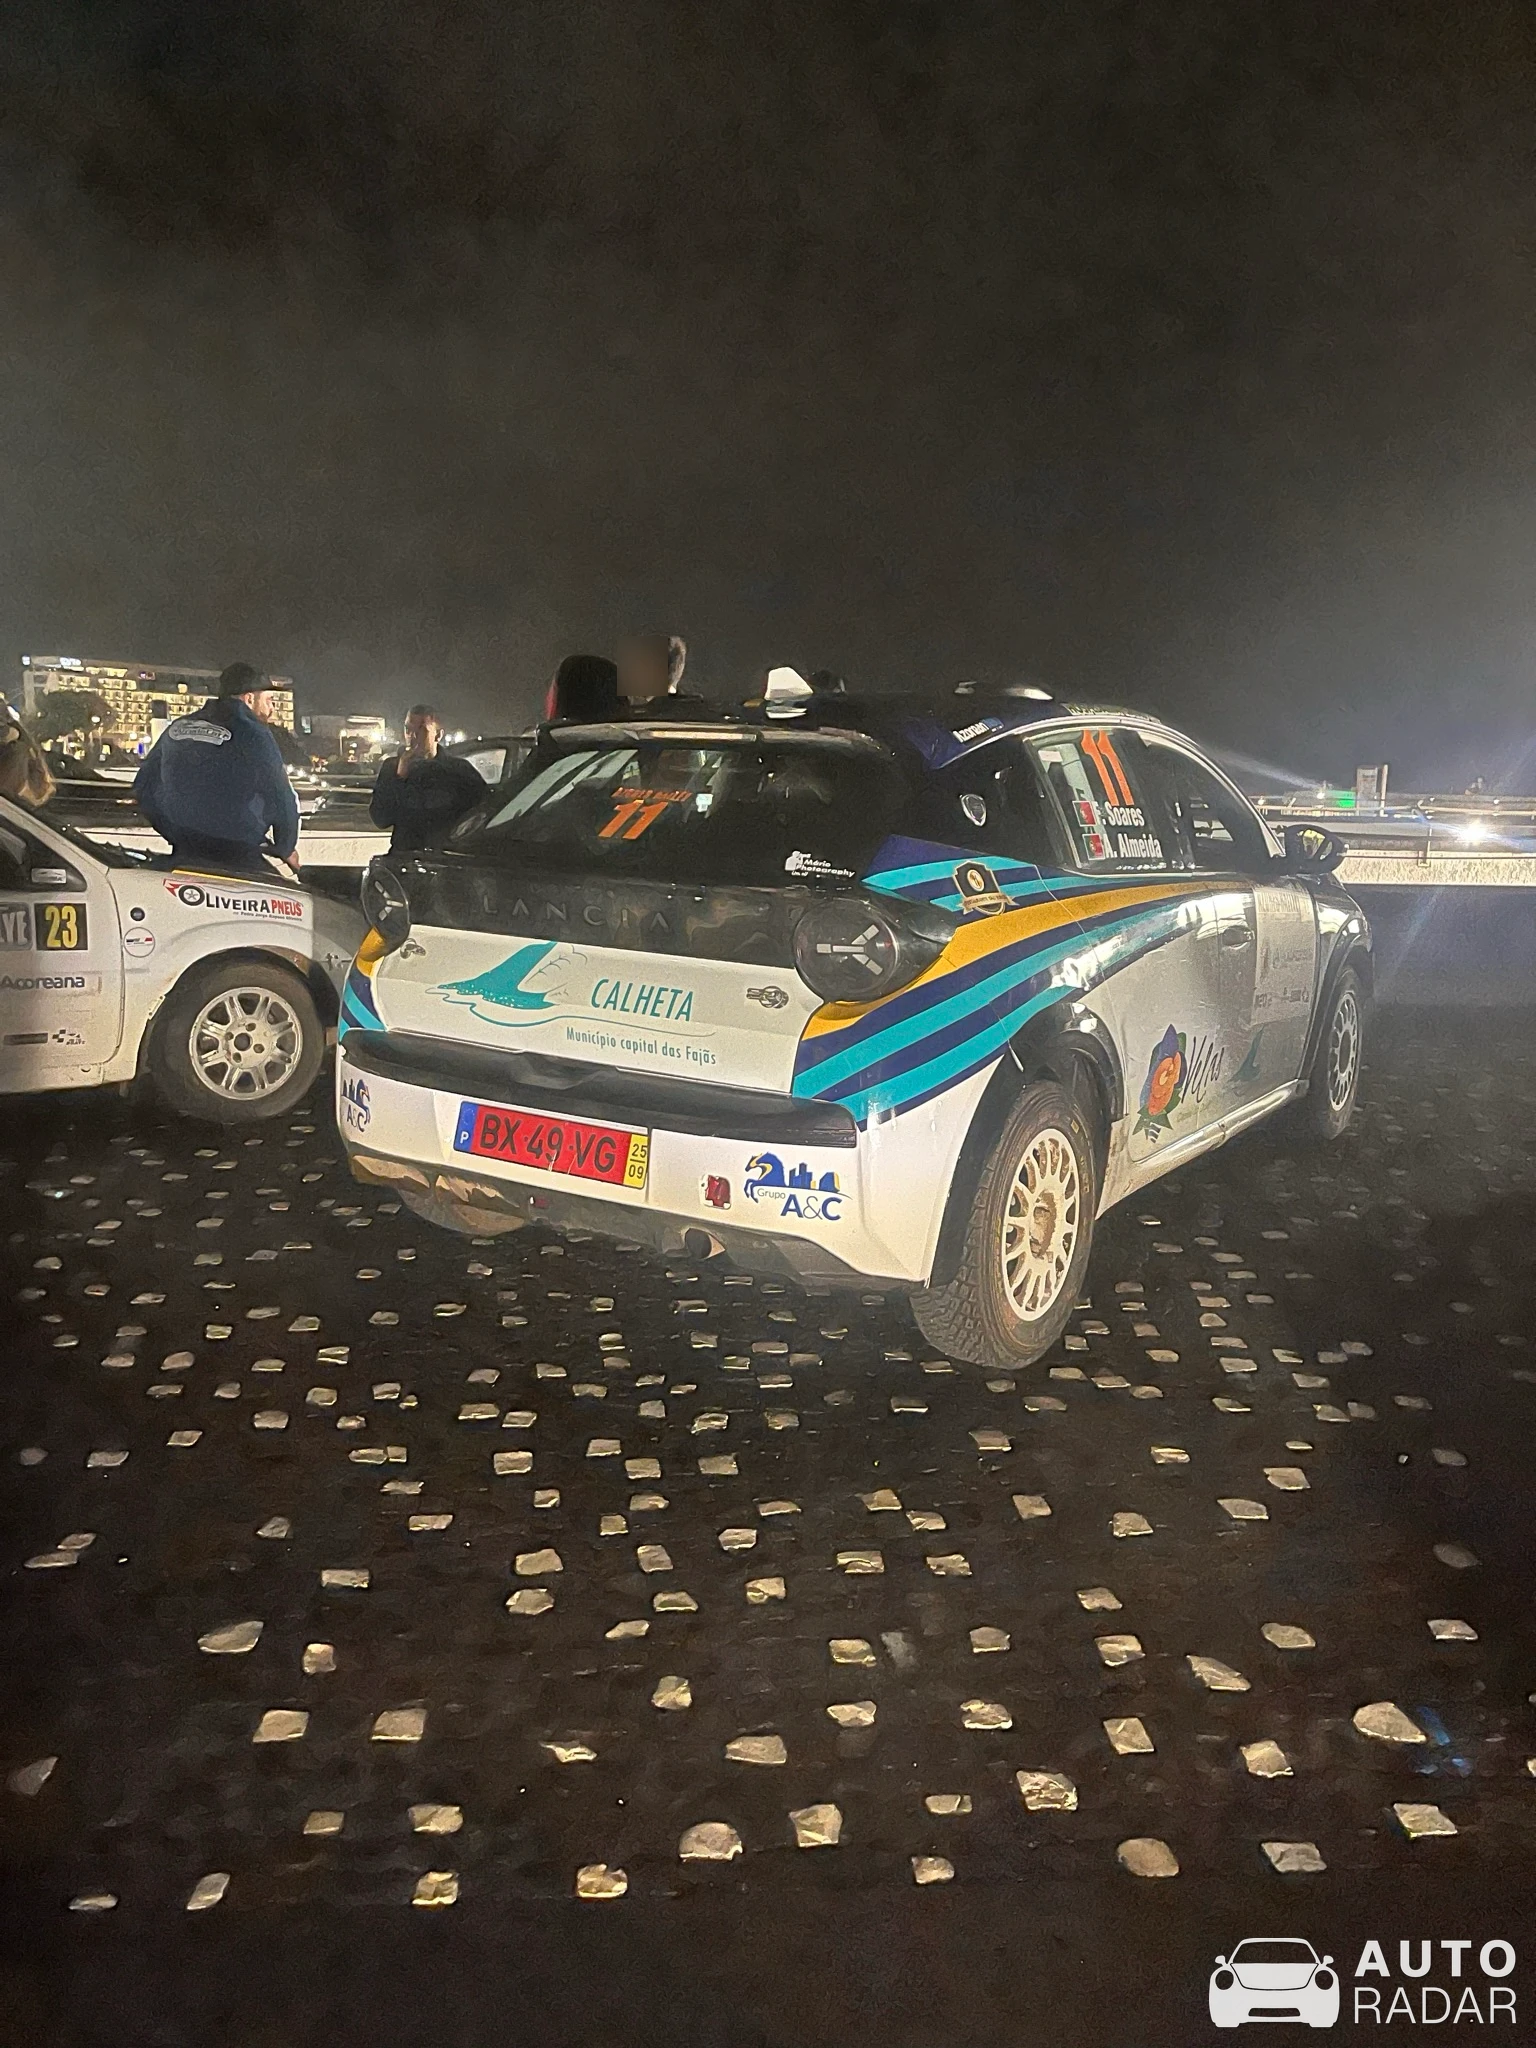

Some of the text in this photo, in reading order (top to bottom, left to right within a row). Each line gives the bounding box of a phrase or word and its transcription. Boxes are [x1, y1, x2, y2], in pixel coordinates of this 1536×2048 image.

[1081, 728, 1134, 806] 11
[598, 799, 668, 839] 11
[1104, 801, 1145, 826] Soares
[1117, 833, 1163, 858] Almeida
[271, 899, 302, 917] PNEUS
[484, 894, 670, 934] LANCIA
[45, 905, 78, 949] 23
[591, 978, 694, 1021] CALHETA
[566, 1026, 716, 1066] Município capital das Fajãs
[460, 1131, 469, 1144] P
[632, 1143, 648, 1158] 25
[628, 1164, 645, 1180] 09
[757, 1188, 786, 1199] Grupo
[780, 1194, 843, 1221] A&C
